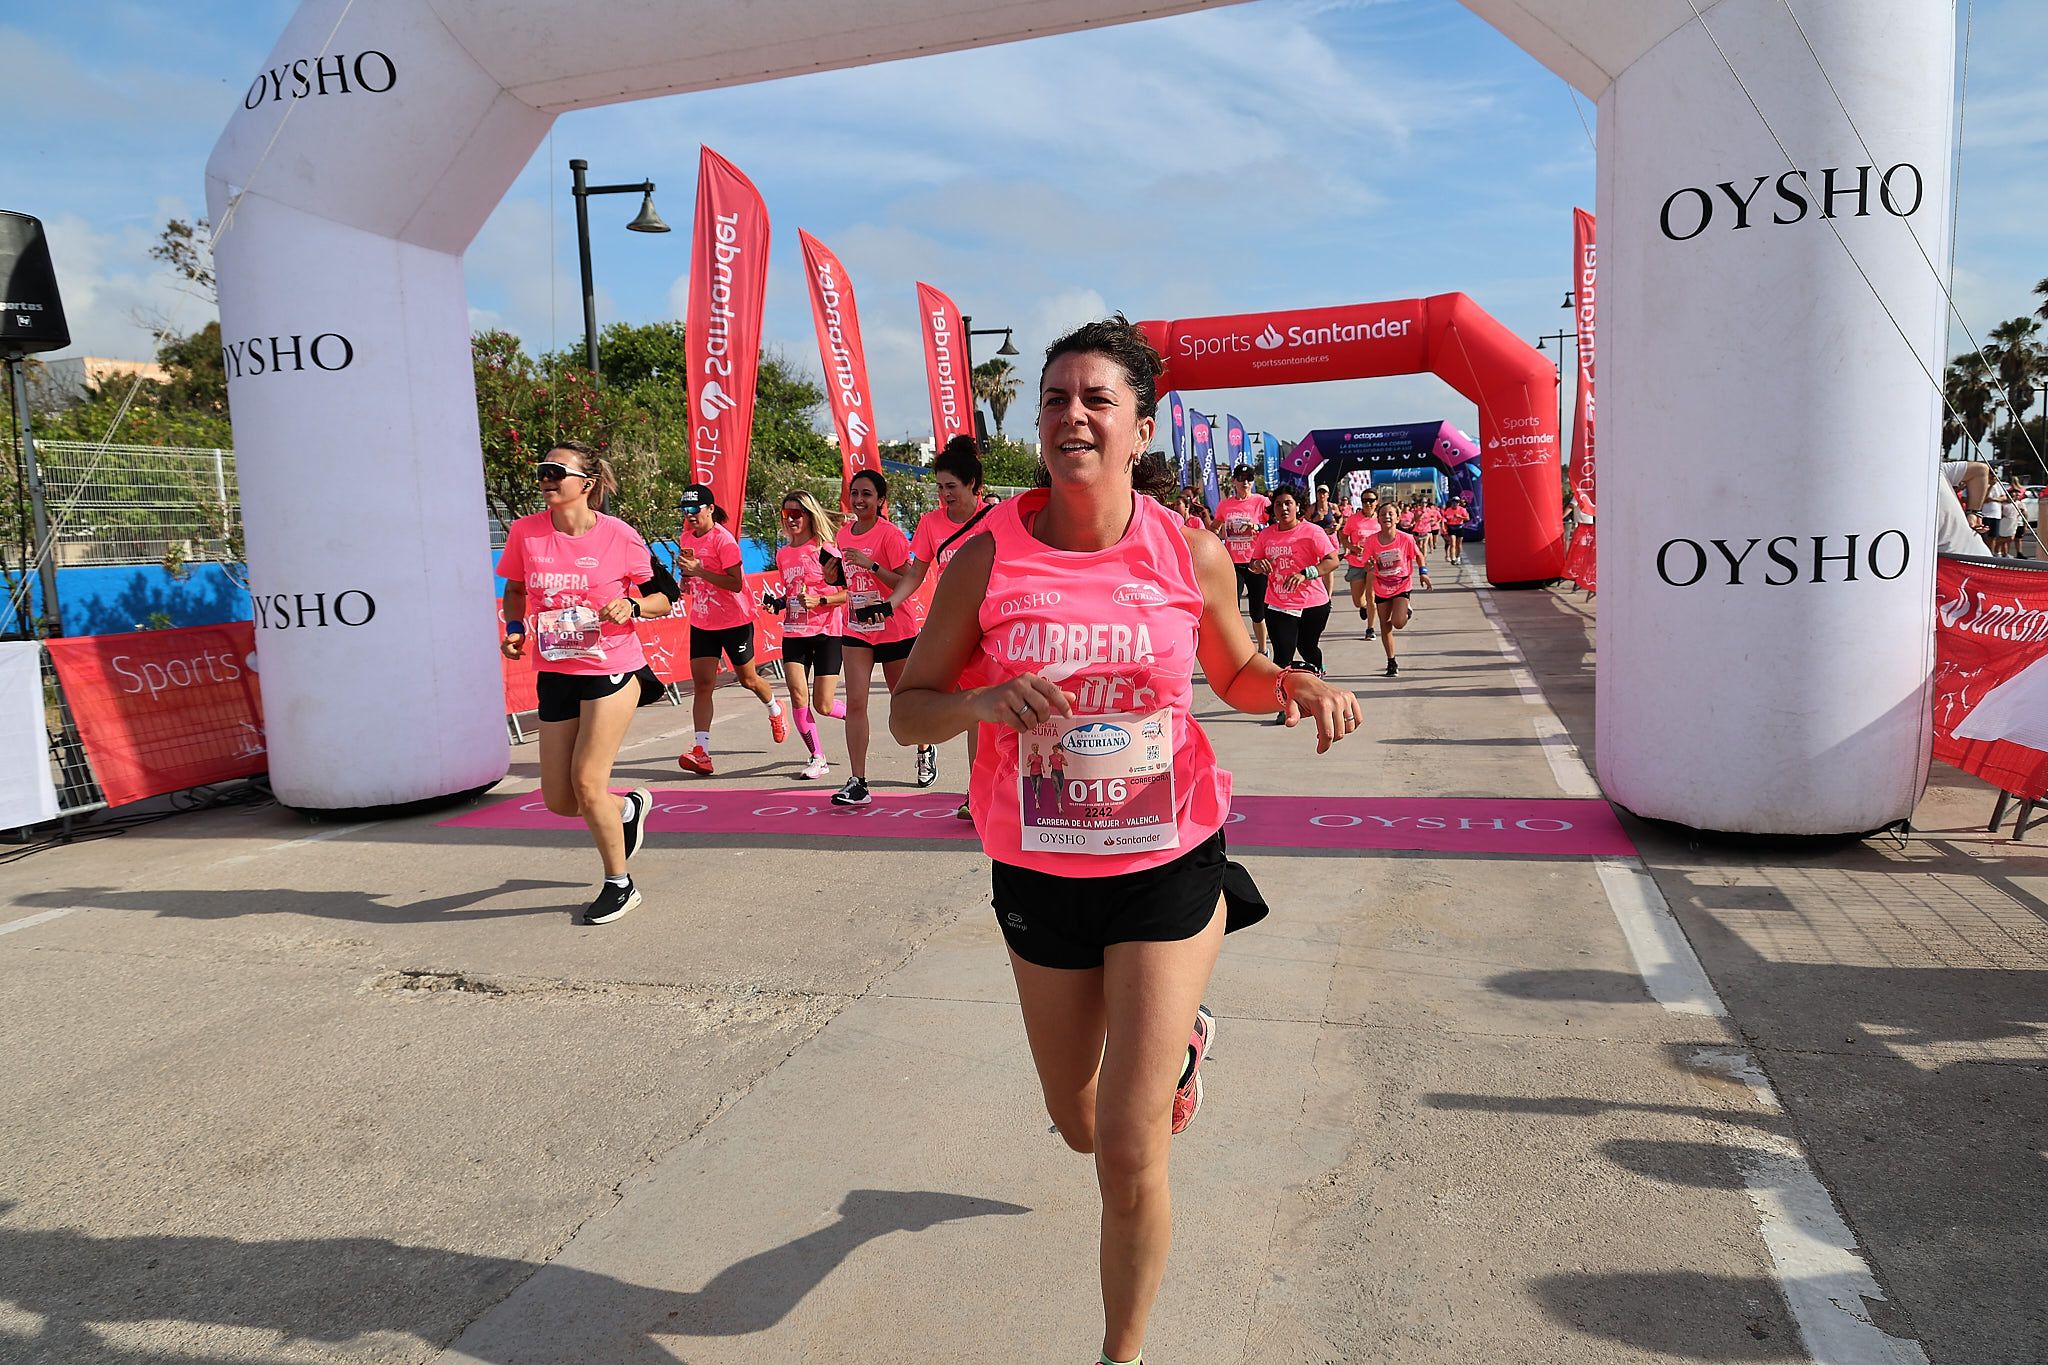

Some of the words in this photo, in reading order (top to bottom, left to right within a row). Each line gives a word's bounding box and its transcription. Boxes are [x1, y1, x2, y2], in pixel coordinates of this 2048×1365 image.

[245, 50, 397, 110] OYSHO
[1659, 162, 1923, 241] OYSHO
[1179, 331, 1251, 360] Sports
[1288, 317, 1412, 348] Santander
[1252, 353, 1330, 369] sportssantander.es
[1503, 414, 1540, 430] Sports
[1501, 432, 1554, 448] Santander
[1656, 529, 1910, 587] OYSHO
[530, 572, 588, 590] CARRERA
[1001, 591, 1061, 615] OYSHO
[1959, 592, 2048, 641] Santan
[560, 632, 585, 641] 016
[1007, 622, 1156, 664] CARRERA
[112, 650, 241, 701] Sports
[1078, 677, 1125, 714] DE
[1032, 727, 1059, 737] SUMA
[1067, 735, 1126, 748] ASTURIANA
[1130, 773, 1169, 785] CORREDORA
[1068, 778, 1128, 803] 016
[753, 805, 960, 819] OYSHO
[1084, 807, 1113, 818] 2242
[1037, 817, 1069, 828] CARRERA
[1071, 819, 1081, 827] DE
[1083, 819, 1092, 828] LA
[1094, 818, 1120, 828] MUJER
[1126, 815, 1160, 826] VALENCIA
[1309, 814, 1574, 832] OYSHO
[1039, 832, 1086, 846] OYSHO
[1116, 833, 1161, 845] Santander
